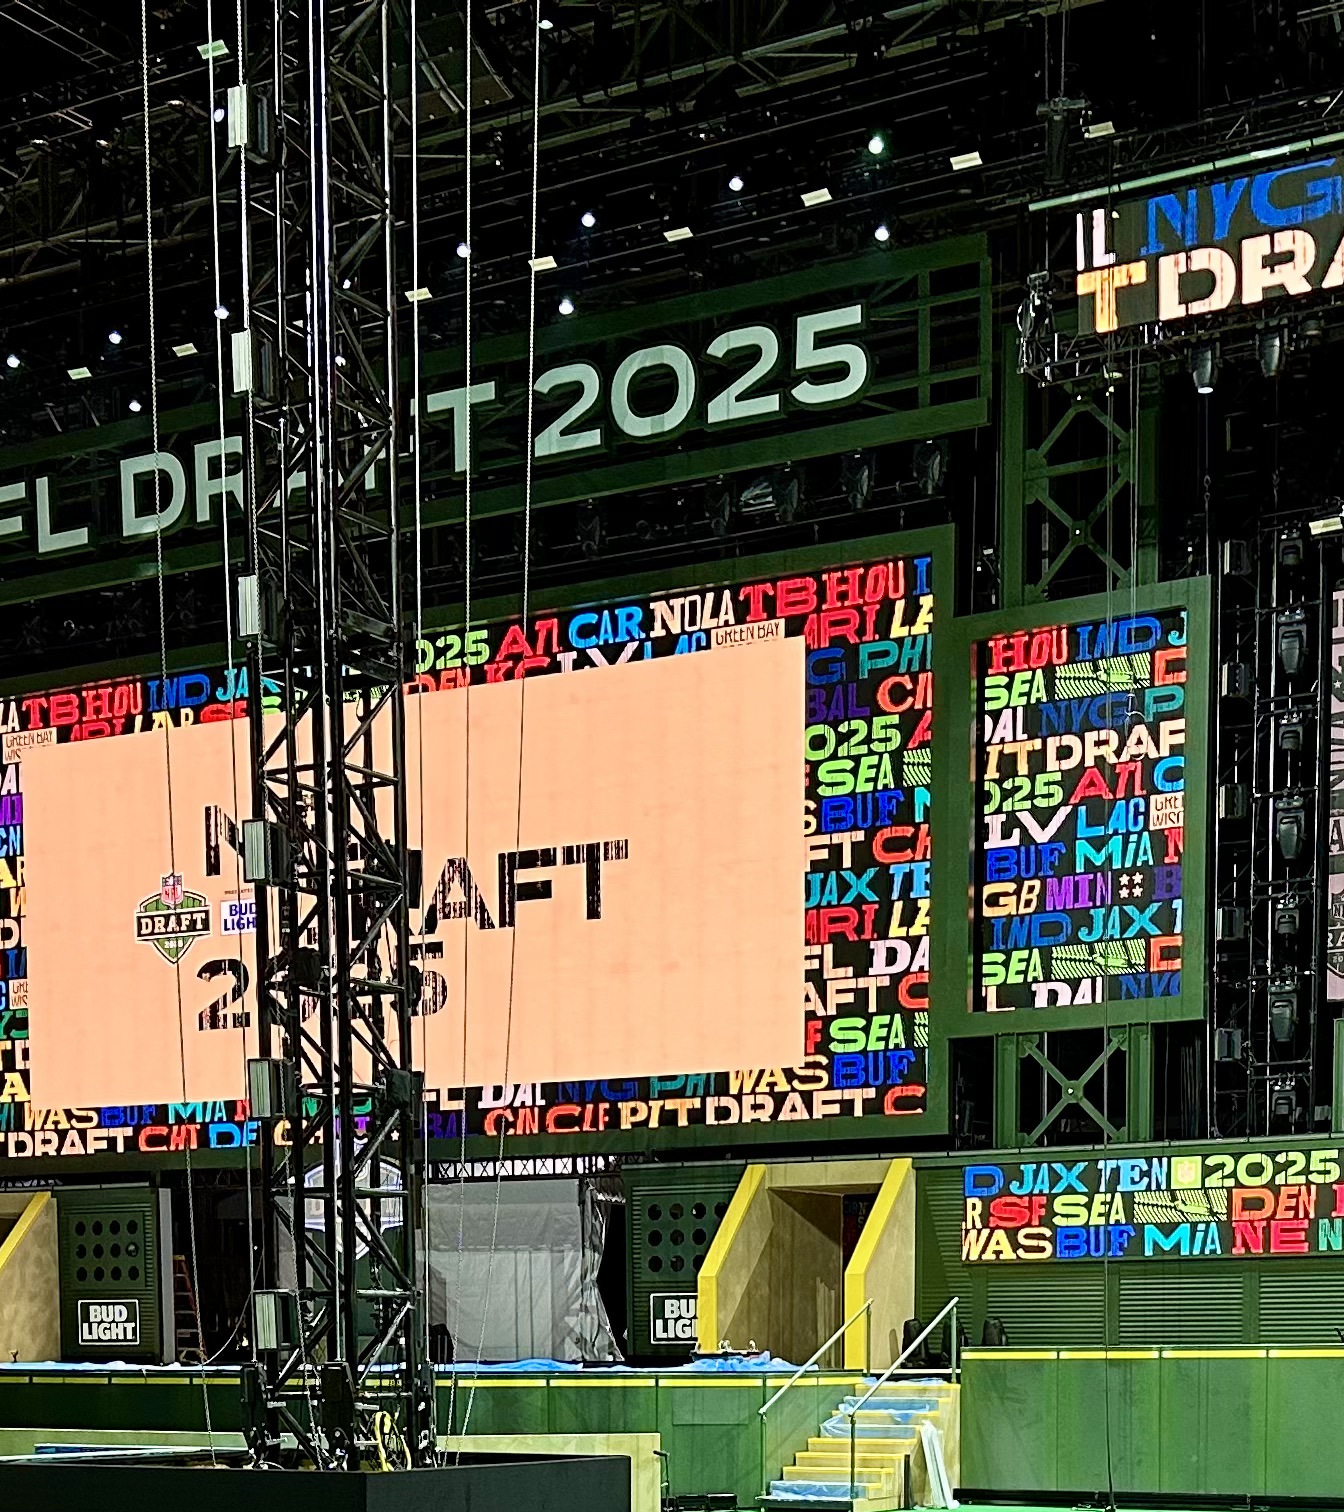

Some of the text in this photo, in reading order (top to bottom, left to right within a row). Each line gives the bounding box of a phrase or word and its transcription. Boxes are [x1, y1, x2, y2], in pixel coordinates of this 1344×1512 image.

[1140, 158, 1343, 256] NYG
[120, 381, 495, 537] DRT
[533, 305, 869, 458] 2025
[81, 682, 143, 723] HOU
[568, 606, 646, 649] CAR
[649, 589, 735, 638] NOLA
[822, 560, 905, 611] HOU
[988, 616, 1162, 675] HOU IND
[817, 753, 896, 797] SEA
[821, 789, 905, 833] BUF
[984, 797, 1145, 849] LV LAC
[986, 831, 1154, 882] BUF MIA
[1046, 871, 1112, 911] MIN
[140, 912, 206, 935] DRAFT
[990, 902, 1163, 950] IND JAX
[829, 1014, 906, 1053] SEA
[833, 1051, 916, 1087] BUF
[8, 1126, 133, 1158] DRAFT
[618, 1097, 701, 1131] PIT
[706, 1087, 876, 1125] DRAFT
[1009, 1161, 1088, 1195] JAX
[1204, 1149, 1341, 1188] 2025
[988, 1195, 1049, 1227] SF
[1052, 1192, 1127, 1226] SEA
[1232, 1185, 1317, 1221] DEN
[961, 1226, 1053, 1261] WAS
[1056, 1223, 1137, 1258] BUF
[1144, 1221, 1223, 1257] MIA
[1232, 1219, 1309, 1255] NE
[89, 1305, 128, 1322] BUD
[665, 1299, 698, 1318] BU
[82, 1322, 135, 1340] LIGHT
